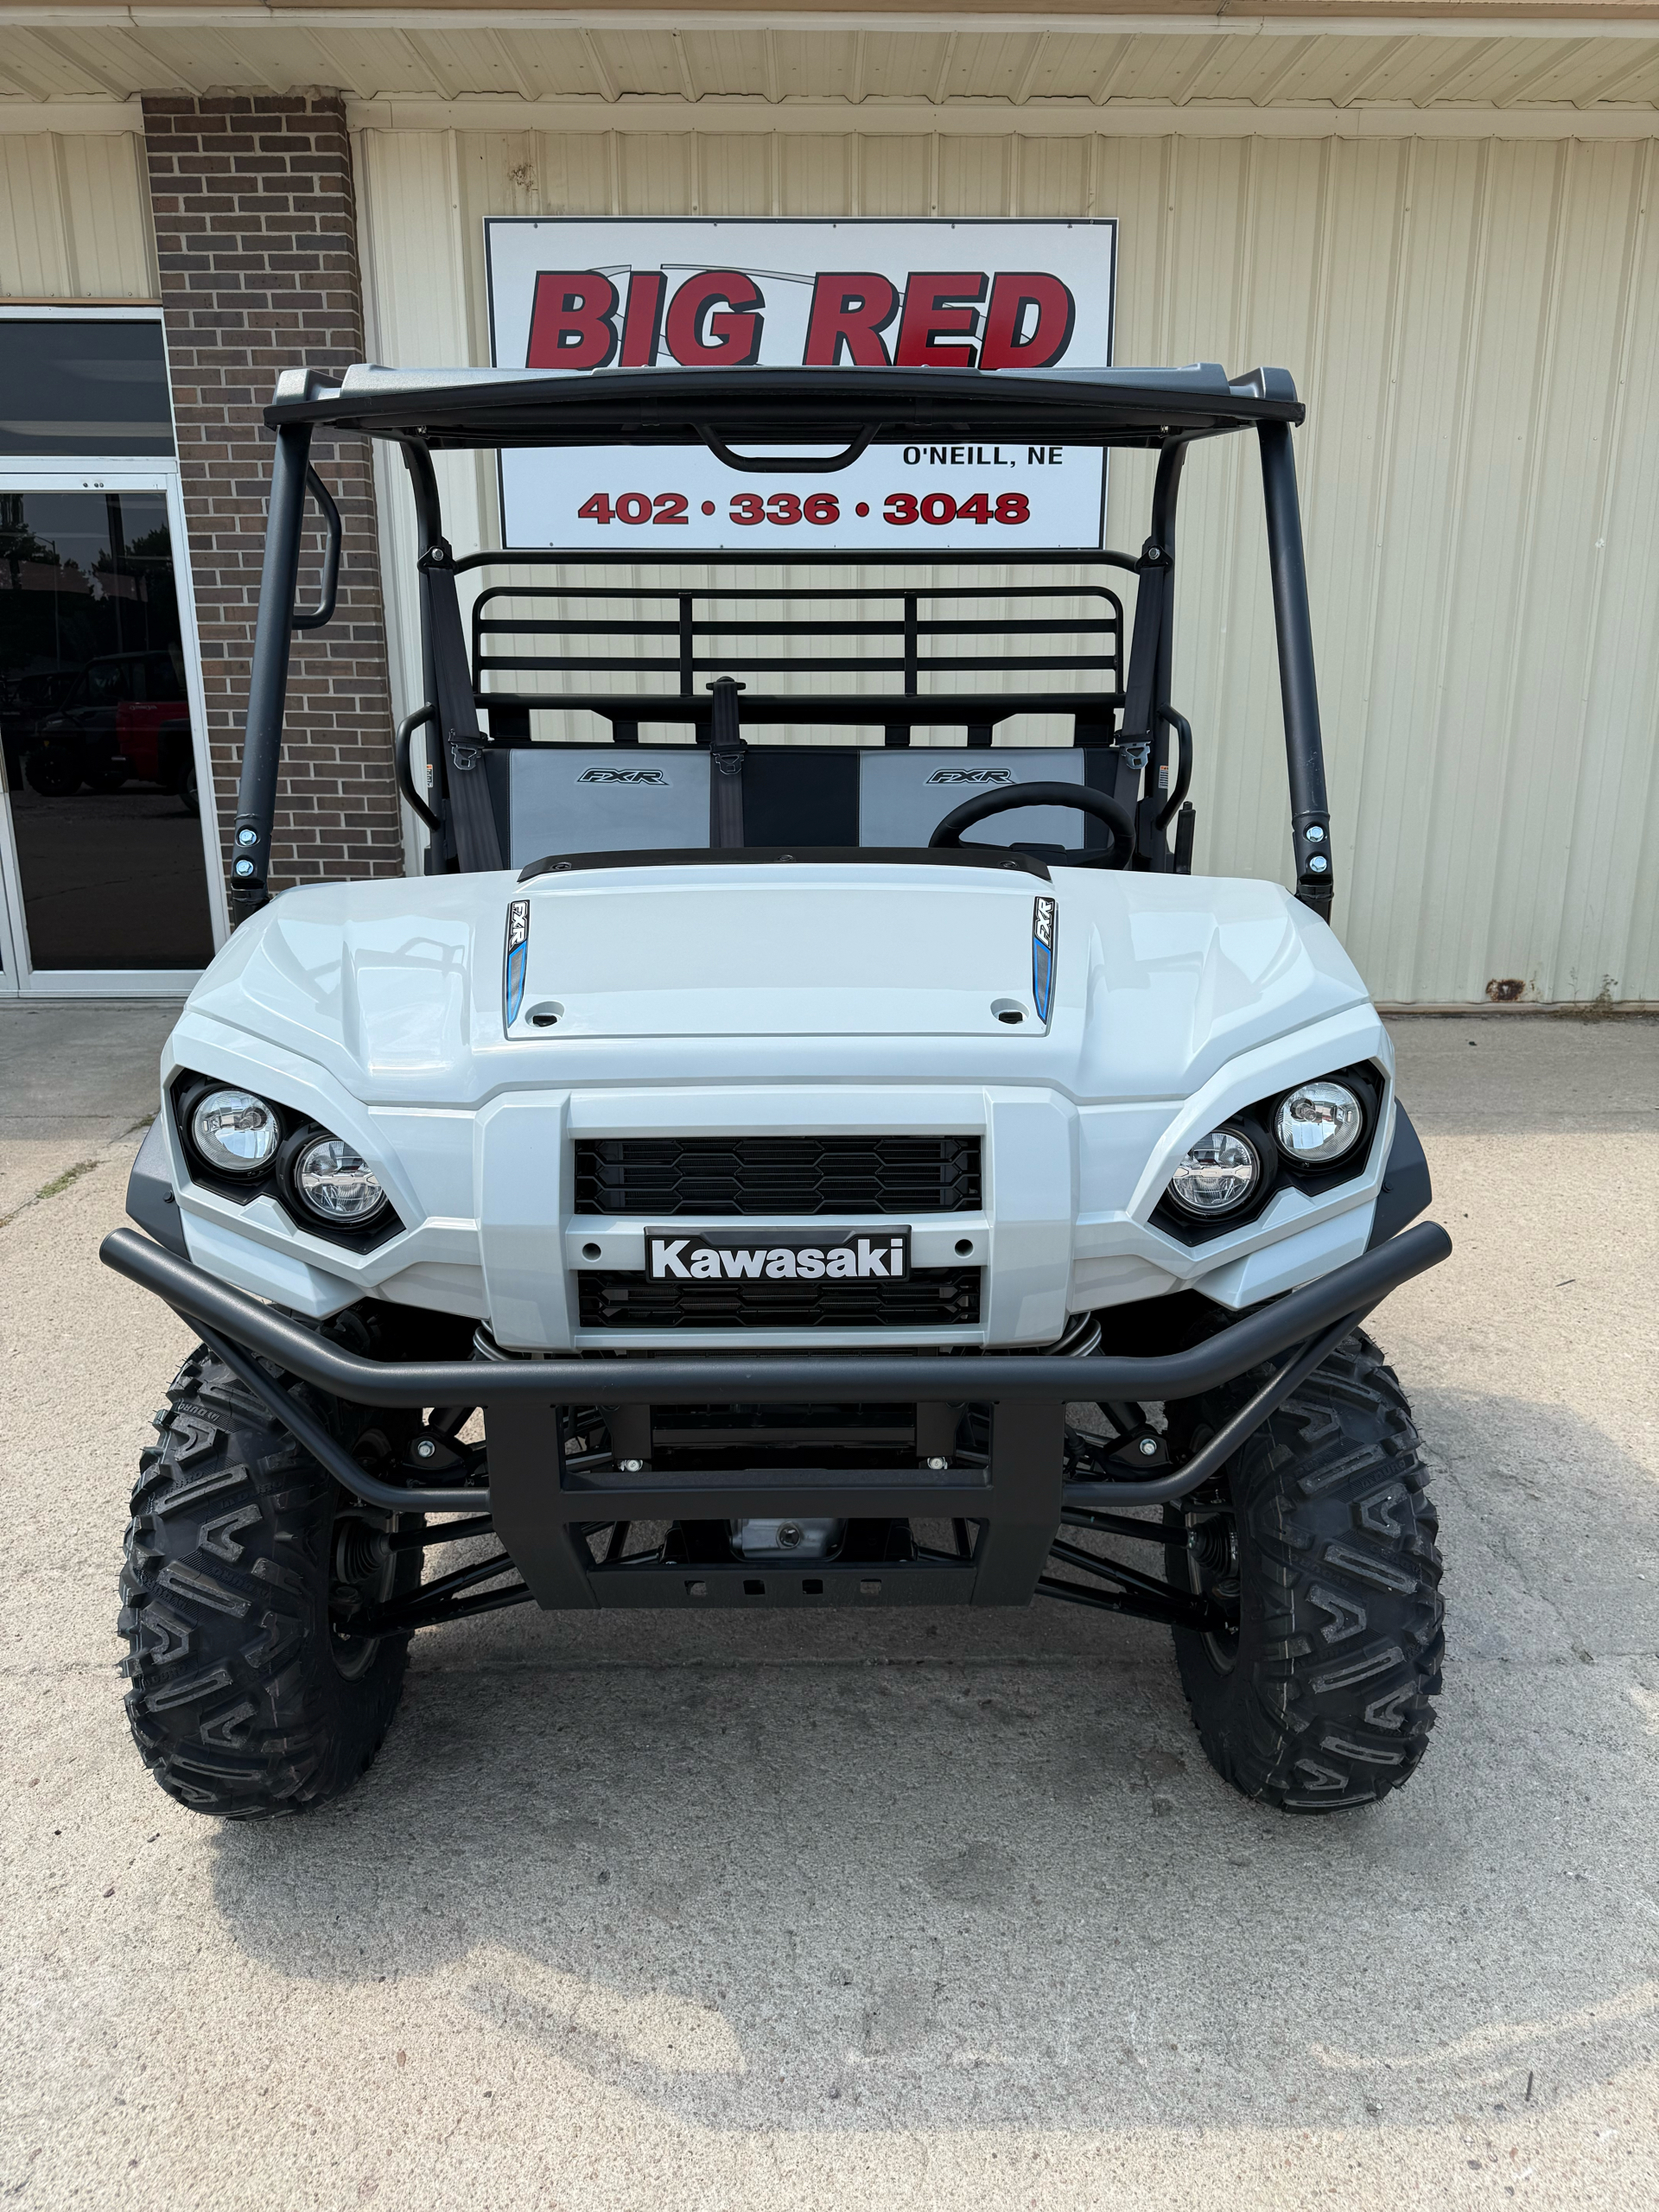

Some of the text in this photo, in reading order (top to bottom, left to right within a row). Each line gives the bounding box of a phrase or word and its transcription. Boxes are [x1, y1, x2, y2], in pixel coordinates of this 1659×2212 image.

[525, 270, 1077, 369] BIG RED
[903, 446, 1063, 467] O'NEILL, NE
[577, 768, 670, 785] FXR
[926, 768, 1017, 784] FXR
[510, 901, 528, 951] FXR
[1035, 897, 1053, 949] FXR
[652, 1238, 903, 1279] Kawasaki
